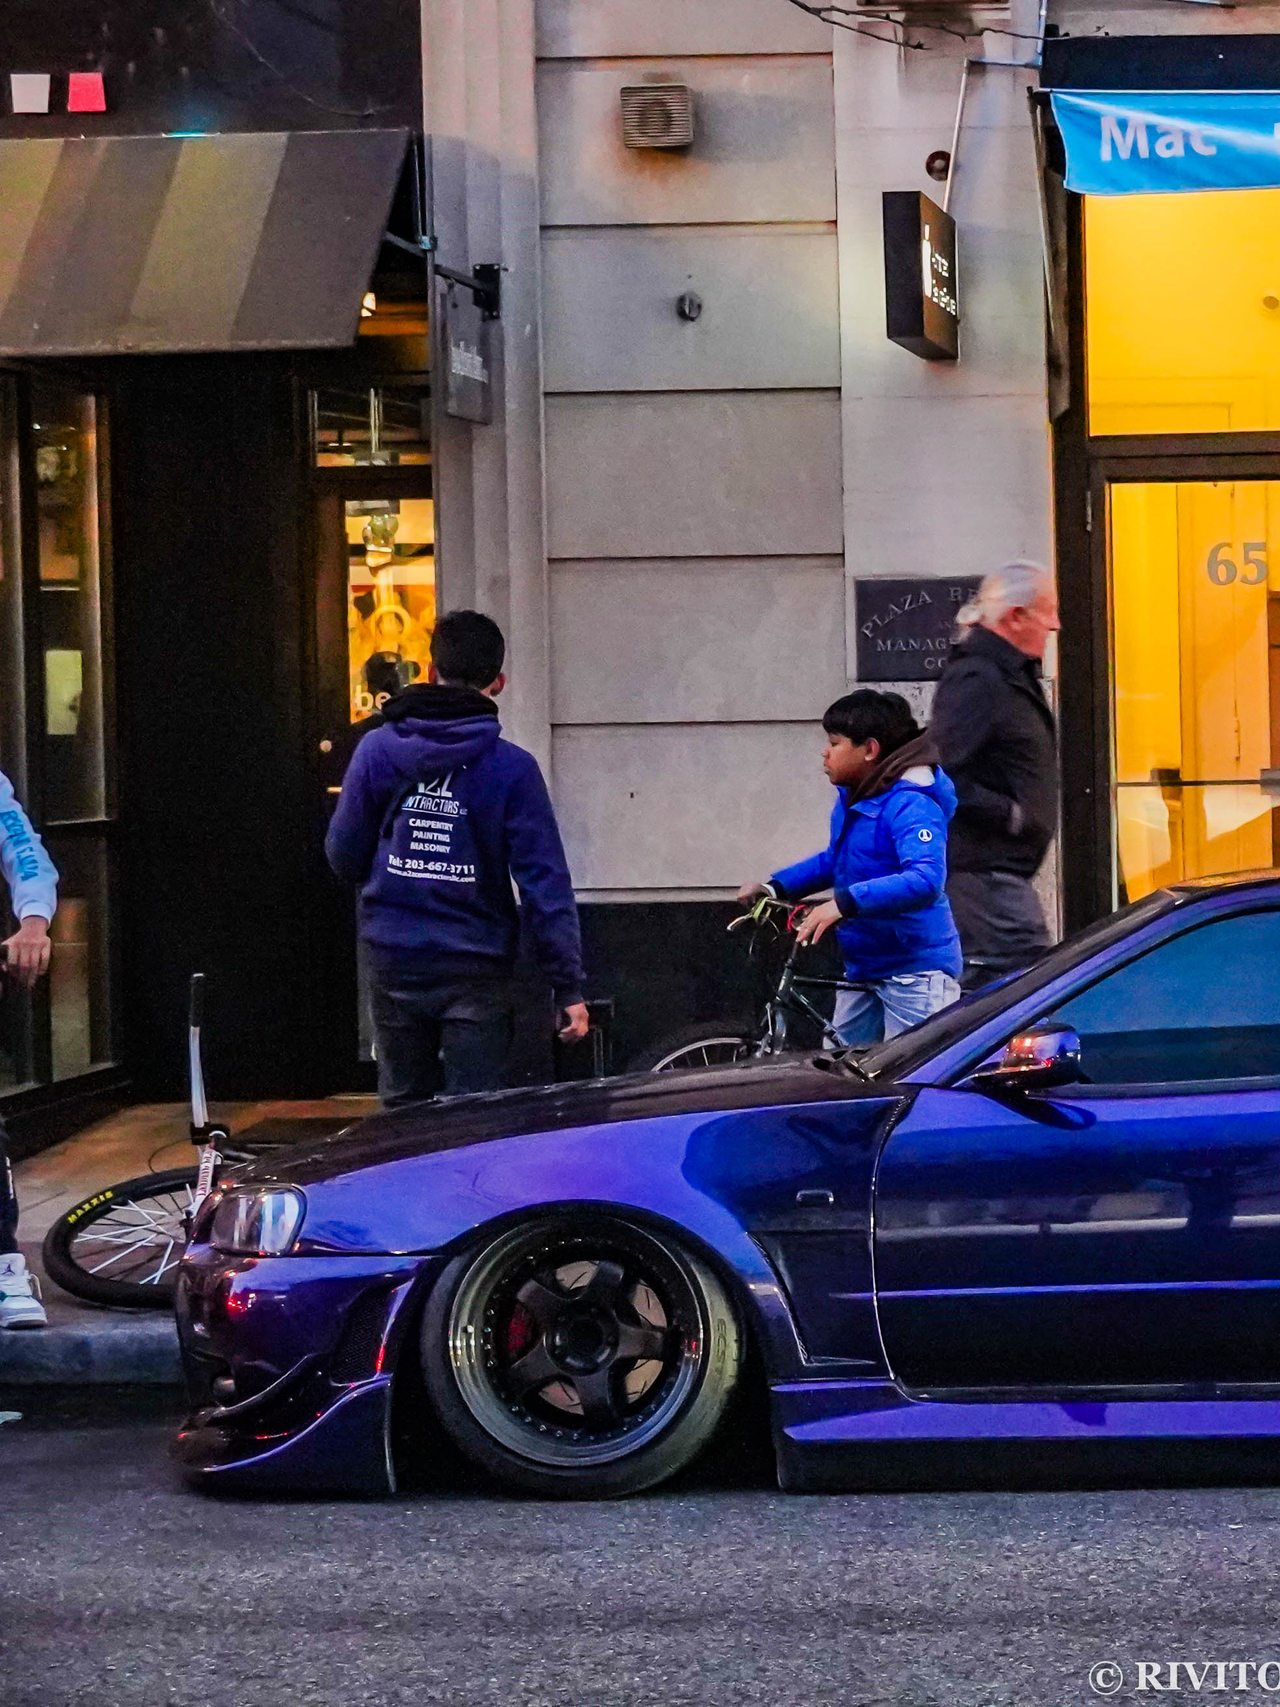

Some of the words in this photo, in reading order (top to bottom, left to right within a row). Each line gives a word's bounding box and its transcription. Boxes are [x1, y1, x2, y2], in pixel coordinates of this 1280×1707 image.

[1101, 115, 1217, 161] Mac
[1206, 541, 1268, 586] 65
[860, 590, 933, 639] PLAZA
[876, 637, 955, 652] MANAG
[402, 795, 460, 815] NTRACTORS
[408, 818, 454, 832] CARPENTRY
[412, 830, 451, 843] PAINTING
[410, 841, 451, 854] MASONRY
[388, 854, 403, 867] Tel:
[405, 858, 475, 875] 203-667-3711
[67, 1190, 114, 1224] MAXXIS
